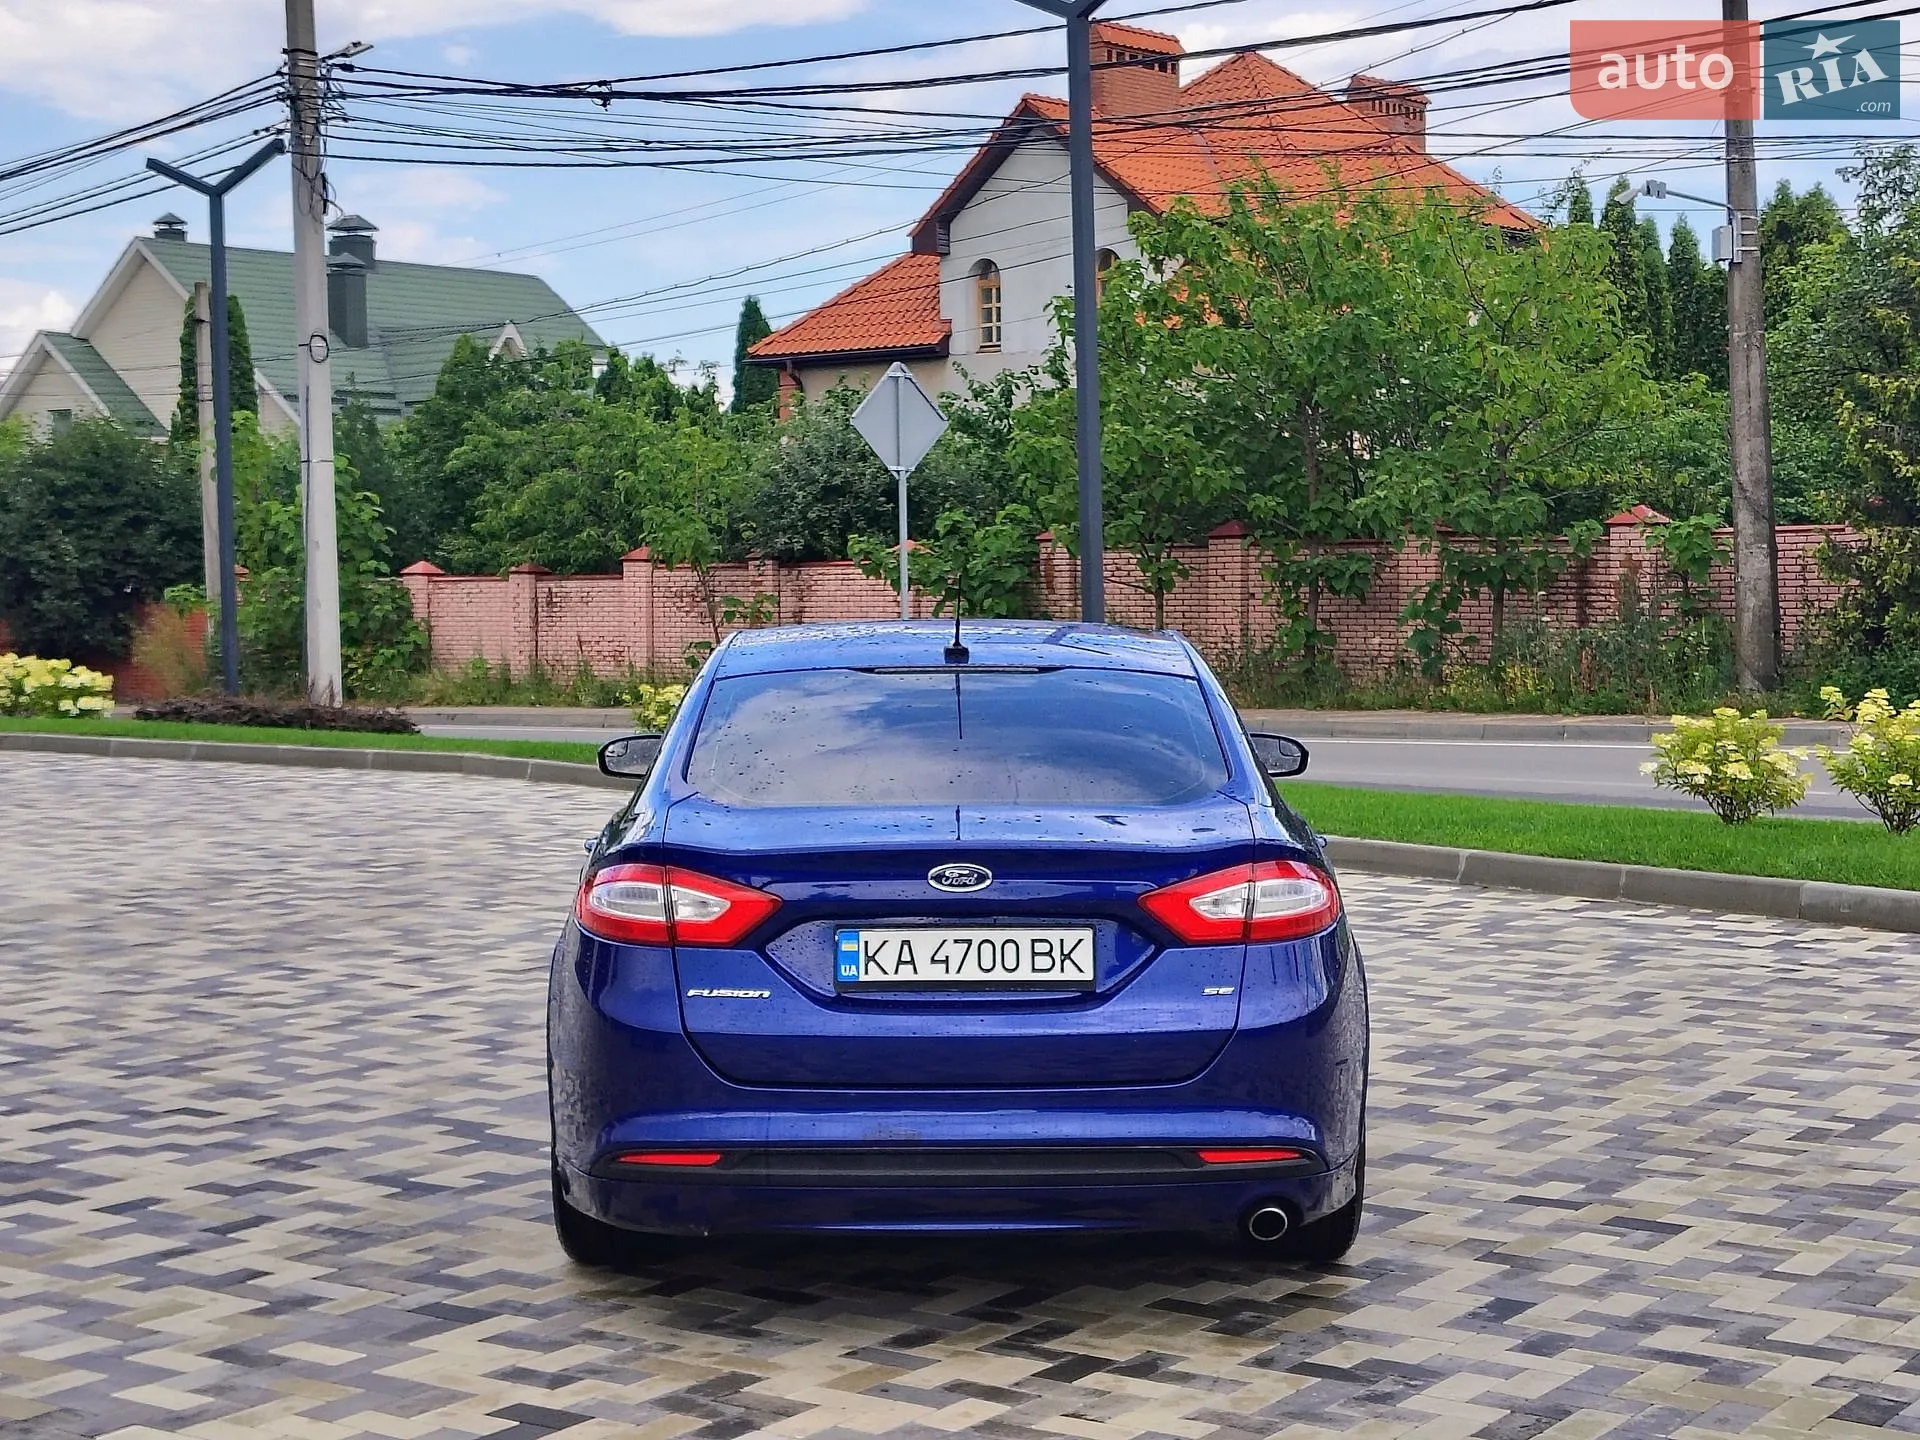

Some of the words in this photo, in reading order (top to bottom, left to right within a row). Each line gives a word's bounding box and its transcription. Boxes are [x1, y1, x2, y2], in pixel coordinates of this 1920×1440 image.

[941, 869, 978, 885] Ford
[863, 939, 918, 976] KA
[930, 938, 1020, 975] 4700
[1030, 938, 1086, 974] BK
[840, 964, 859, 977] UA
[686, 988, 771, 999] FUSION
[1202, 987, 1235, 996] SE
